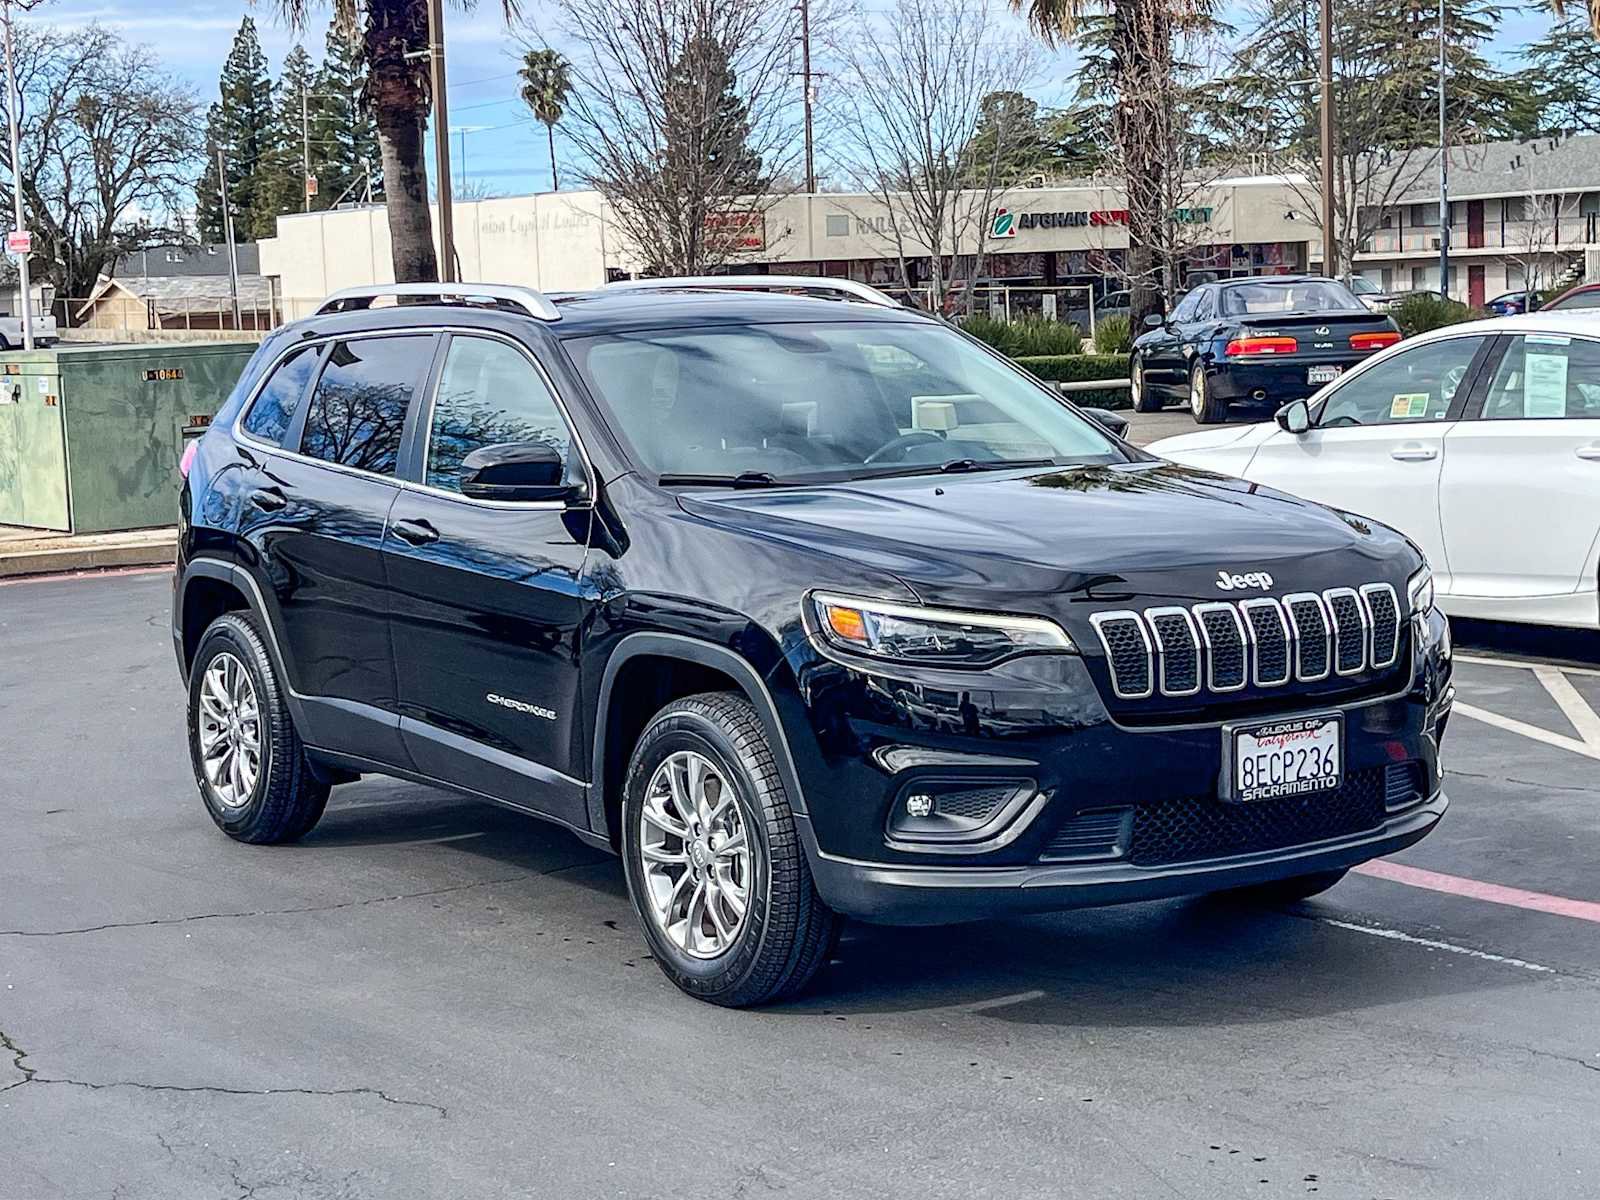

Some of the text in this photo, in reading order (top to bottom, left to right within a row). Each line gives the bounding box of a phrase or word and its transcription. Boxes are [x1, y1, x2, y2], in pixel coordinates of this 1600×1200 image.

[1019, 211, 1088, 229] AFGHAN
[1216, 570, 1273, 591] Jeep
[486, 693, 557, 720] CHEROKEE
[1269, 721, 1304, 735] LEXUS
[1242, 743, 1334, 788] 8ECP236
[1242, 775, 1337, 802] SACRAMENTO
